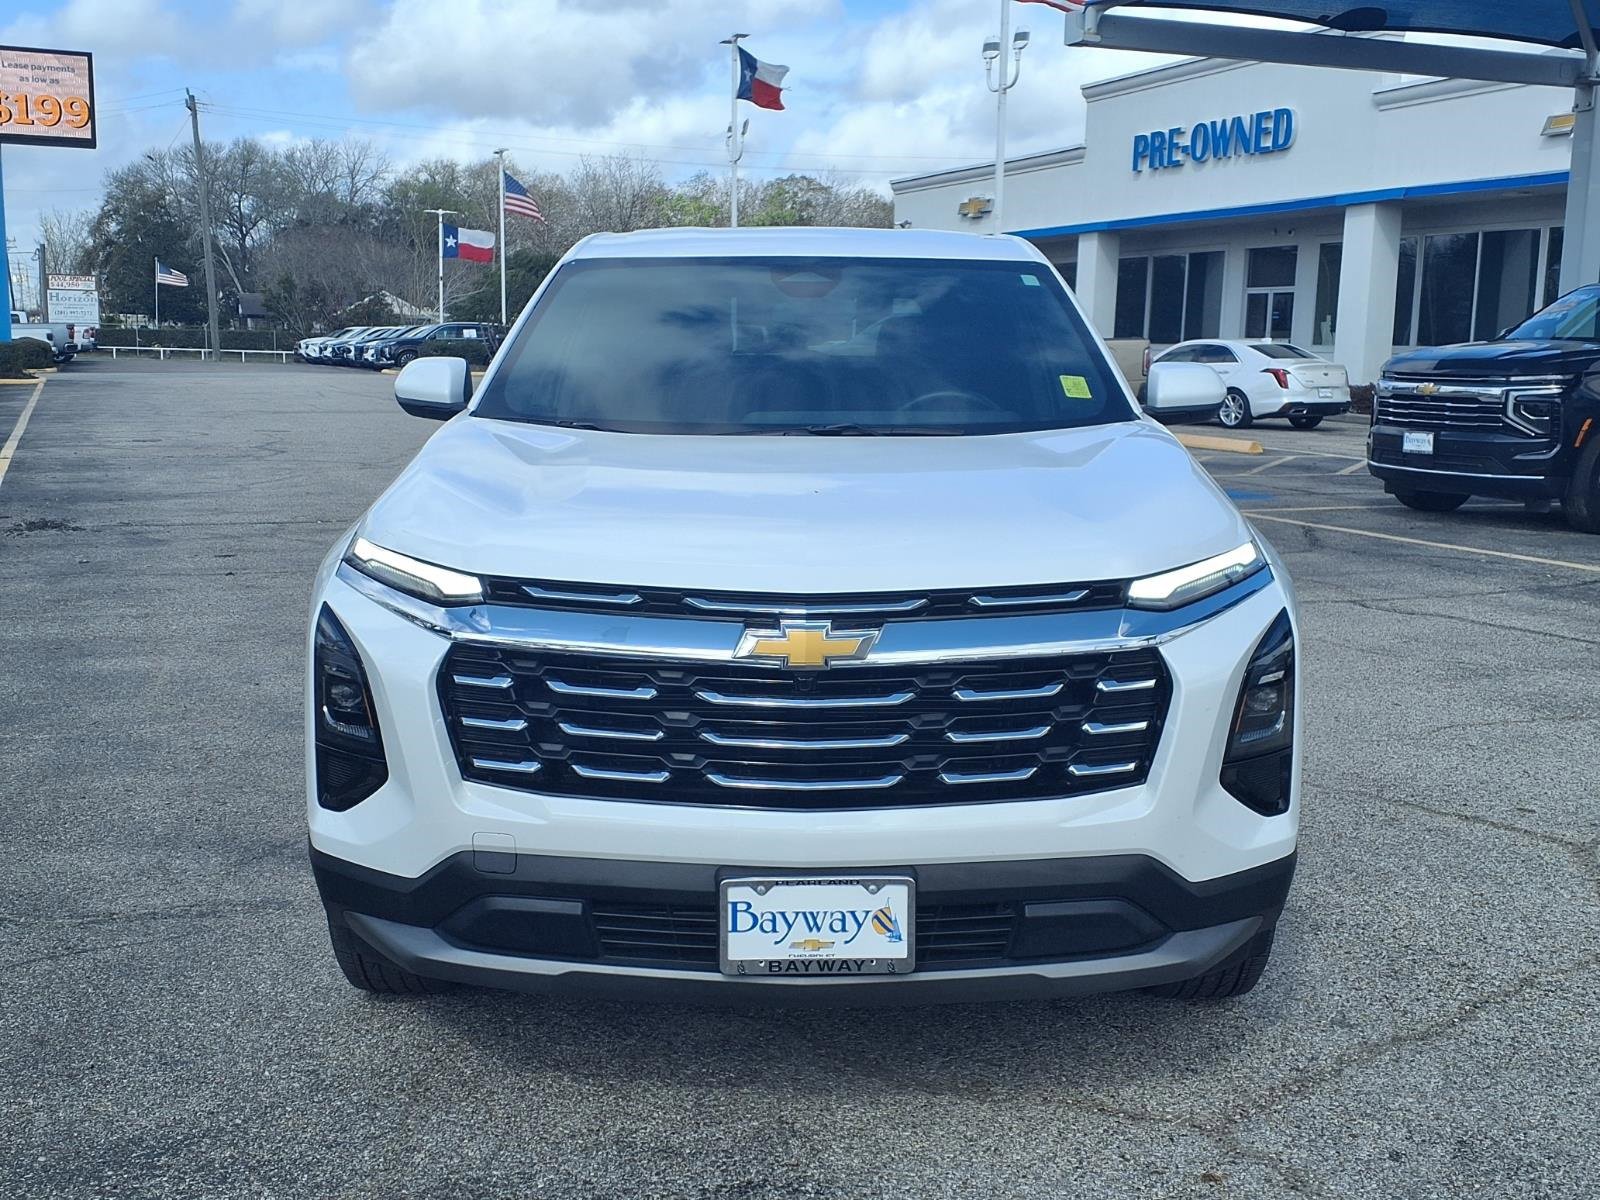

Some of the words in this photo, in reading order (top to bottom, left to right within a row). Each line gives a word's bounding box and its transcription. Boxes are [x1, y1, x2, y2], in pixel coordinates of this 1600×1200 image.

[2, 60, 29, 70] Lease
[31, 63, 76, 74] payments
[19, 75, 29, 83] as
[32, 75, 47, 83] low
[49, 77, 60, 85] as
[1132, 107, 1295, 173] PRE-OWNED
[49, 292, 98, 303] Horizon
[728, 901, 872, 945] Bayway
[768, 960, 866, 973] BAYWAY
